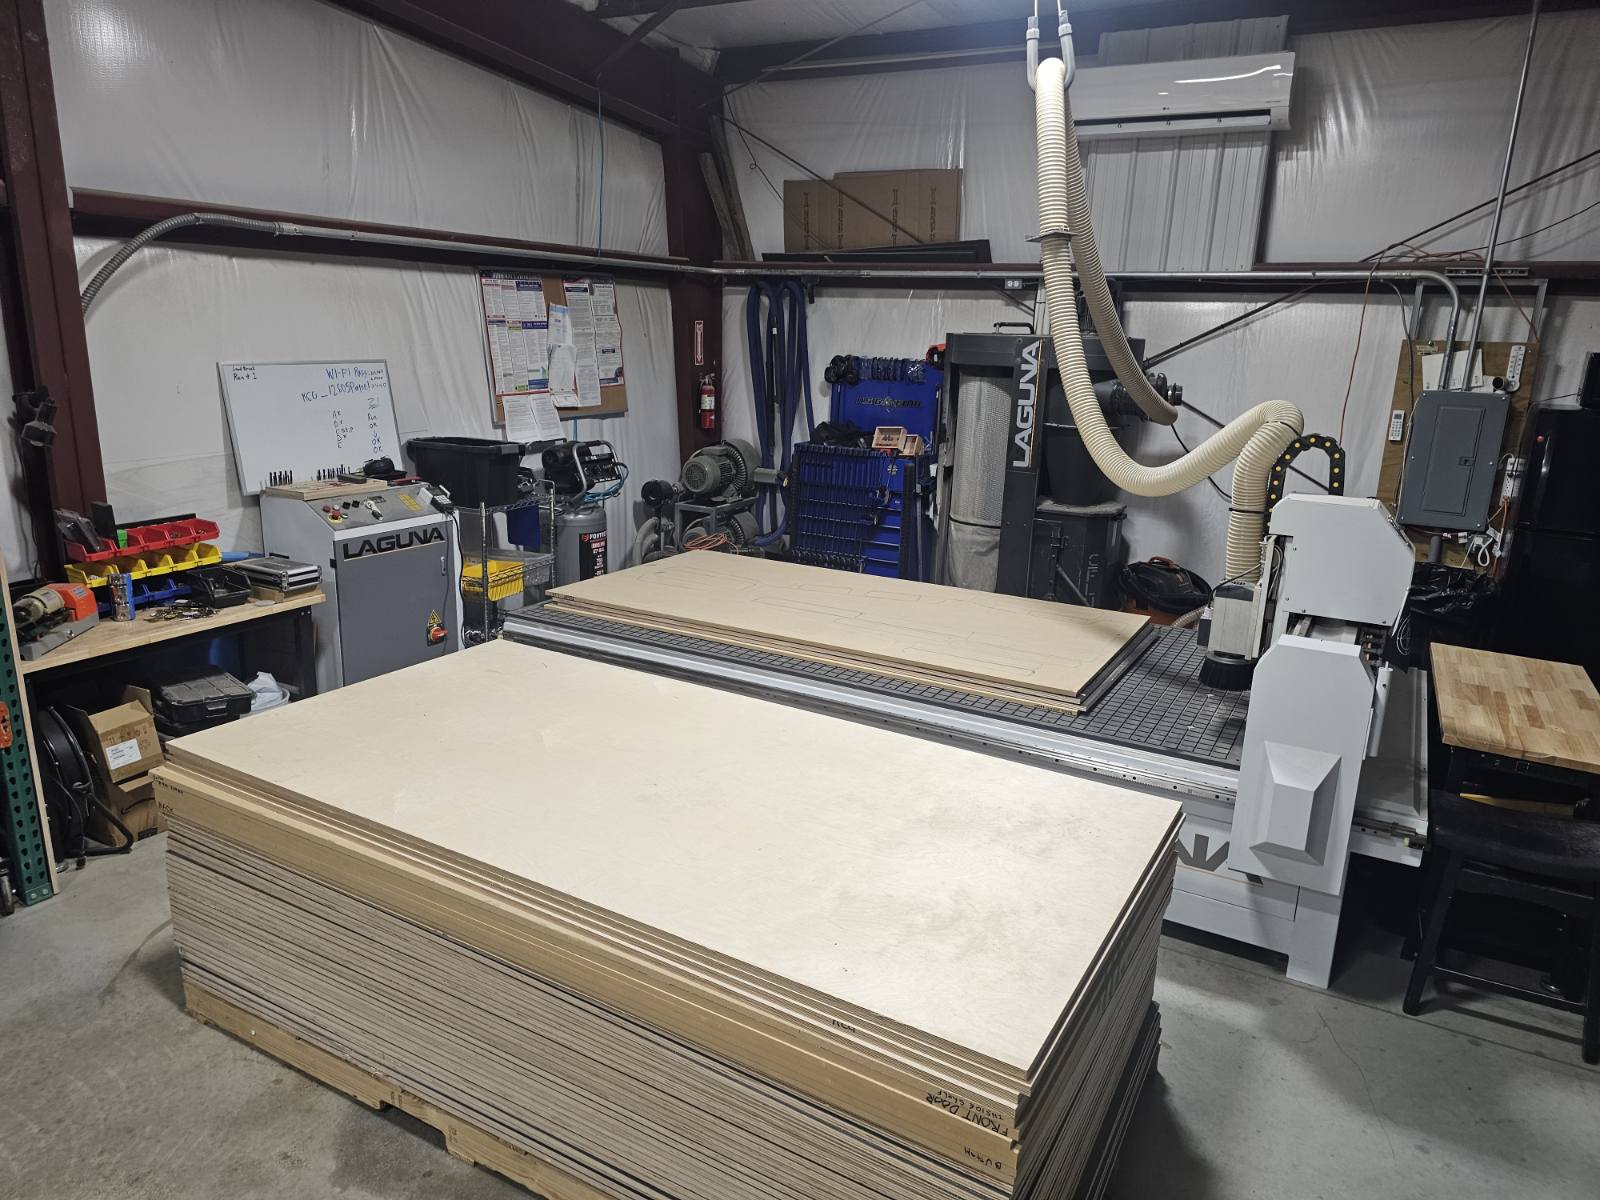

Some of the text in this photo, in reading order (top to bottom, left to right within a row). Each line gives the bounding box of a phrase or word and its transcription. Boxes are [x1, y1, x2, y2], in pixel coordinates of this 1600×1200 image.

[1012, 340, 1041, 468] LAGUNA
[343, 527, 445, 560] LAGUNA
[925, 1093, 1009, 1137] FRONT DOOR
